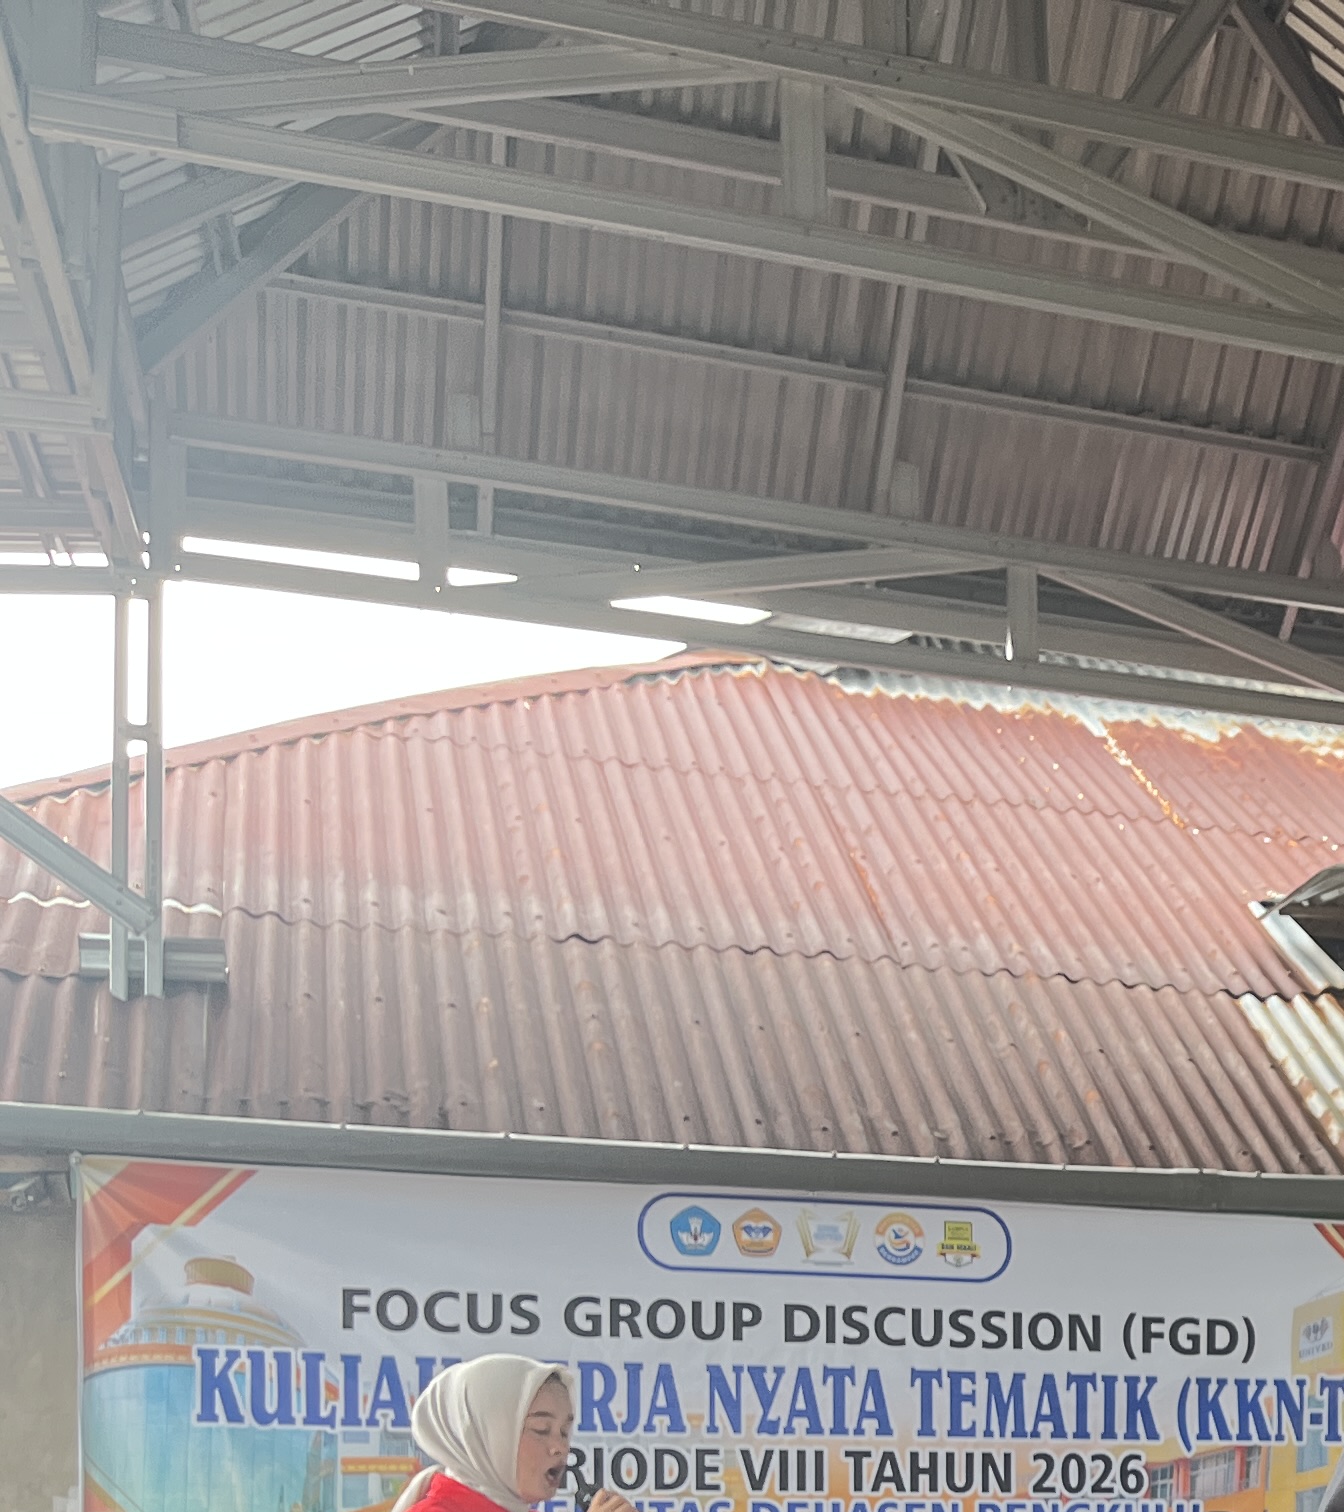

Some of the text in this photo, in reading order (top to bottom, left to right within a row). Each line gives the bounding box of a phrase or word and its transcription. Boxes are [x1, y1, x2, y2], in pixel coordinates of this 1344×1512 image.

[342, 1288, 1256, 1364] FOCUS GROUP DISCUSSION (FGD)
[577, 1359, 687, 1435] RJA
[706, 1362, 894, 1440] NYATA
[910, 1367, 1162, 1442] TEMATIK
[560, 1447, 1146, 1496] RIODE VIII TAHUN 2026
